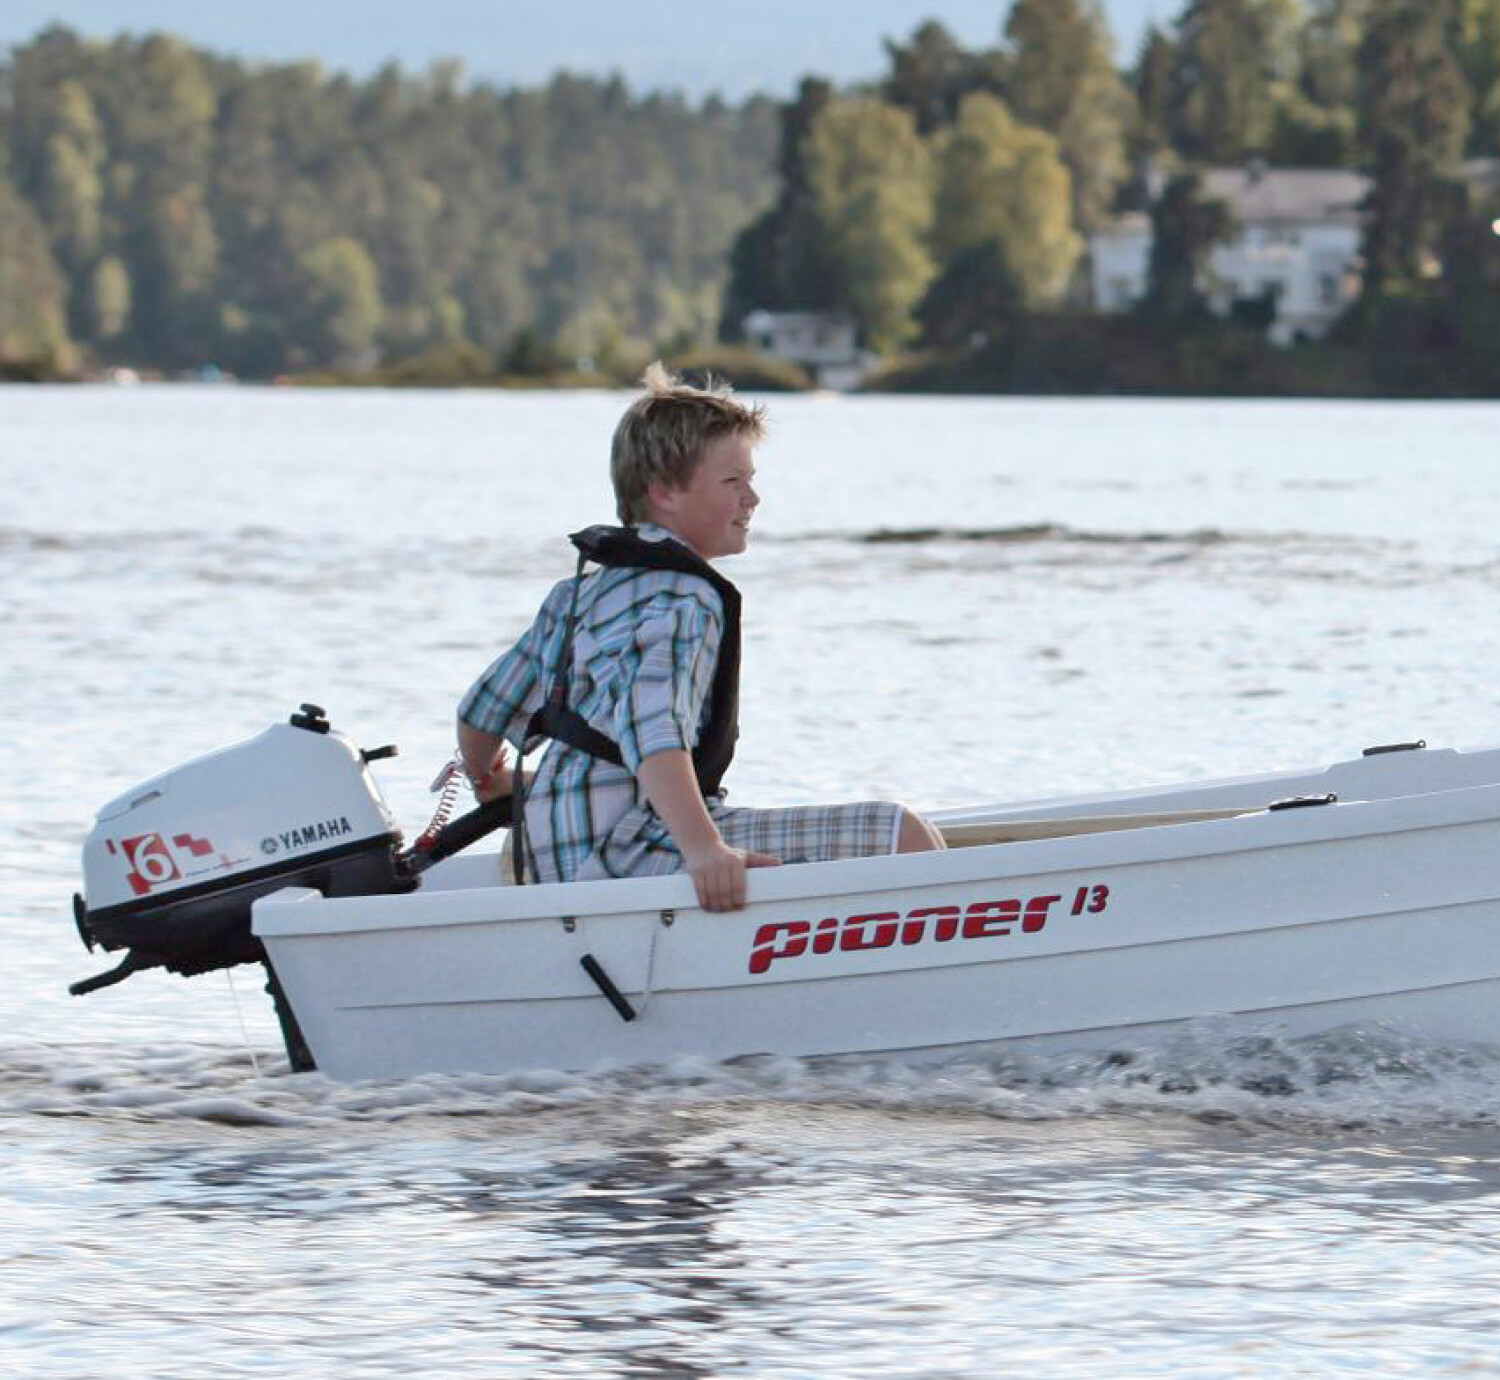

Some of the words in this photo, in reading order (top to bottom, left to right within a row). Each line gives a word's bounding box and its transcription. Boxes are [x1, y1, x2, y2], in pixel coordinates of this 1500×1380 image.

[133, 833, 175, 883] 6
[278, 816, 353, 850] YAMAHA
[748, 894, 1062, 975] pioner
[1070, 884, 1110, 916] 13
